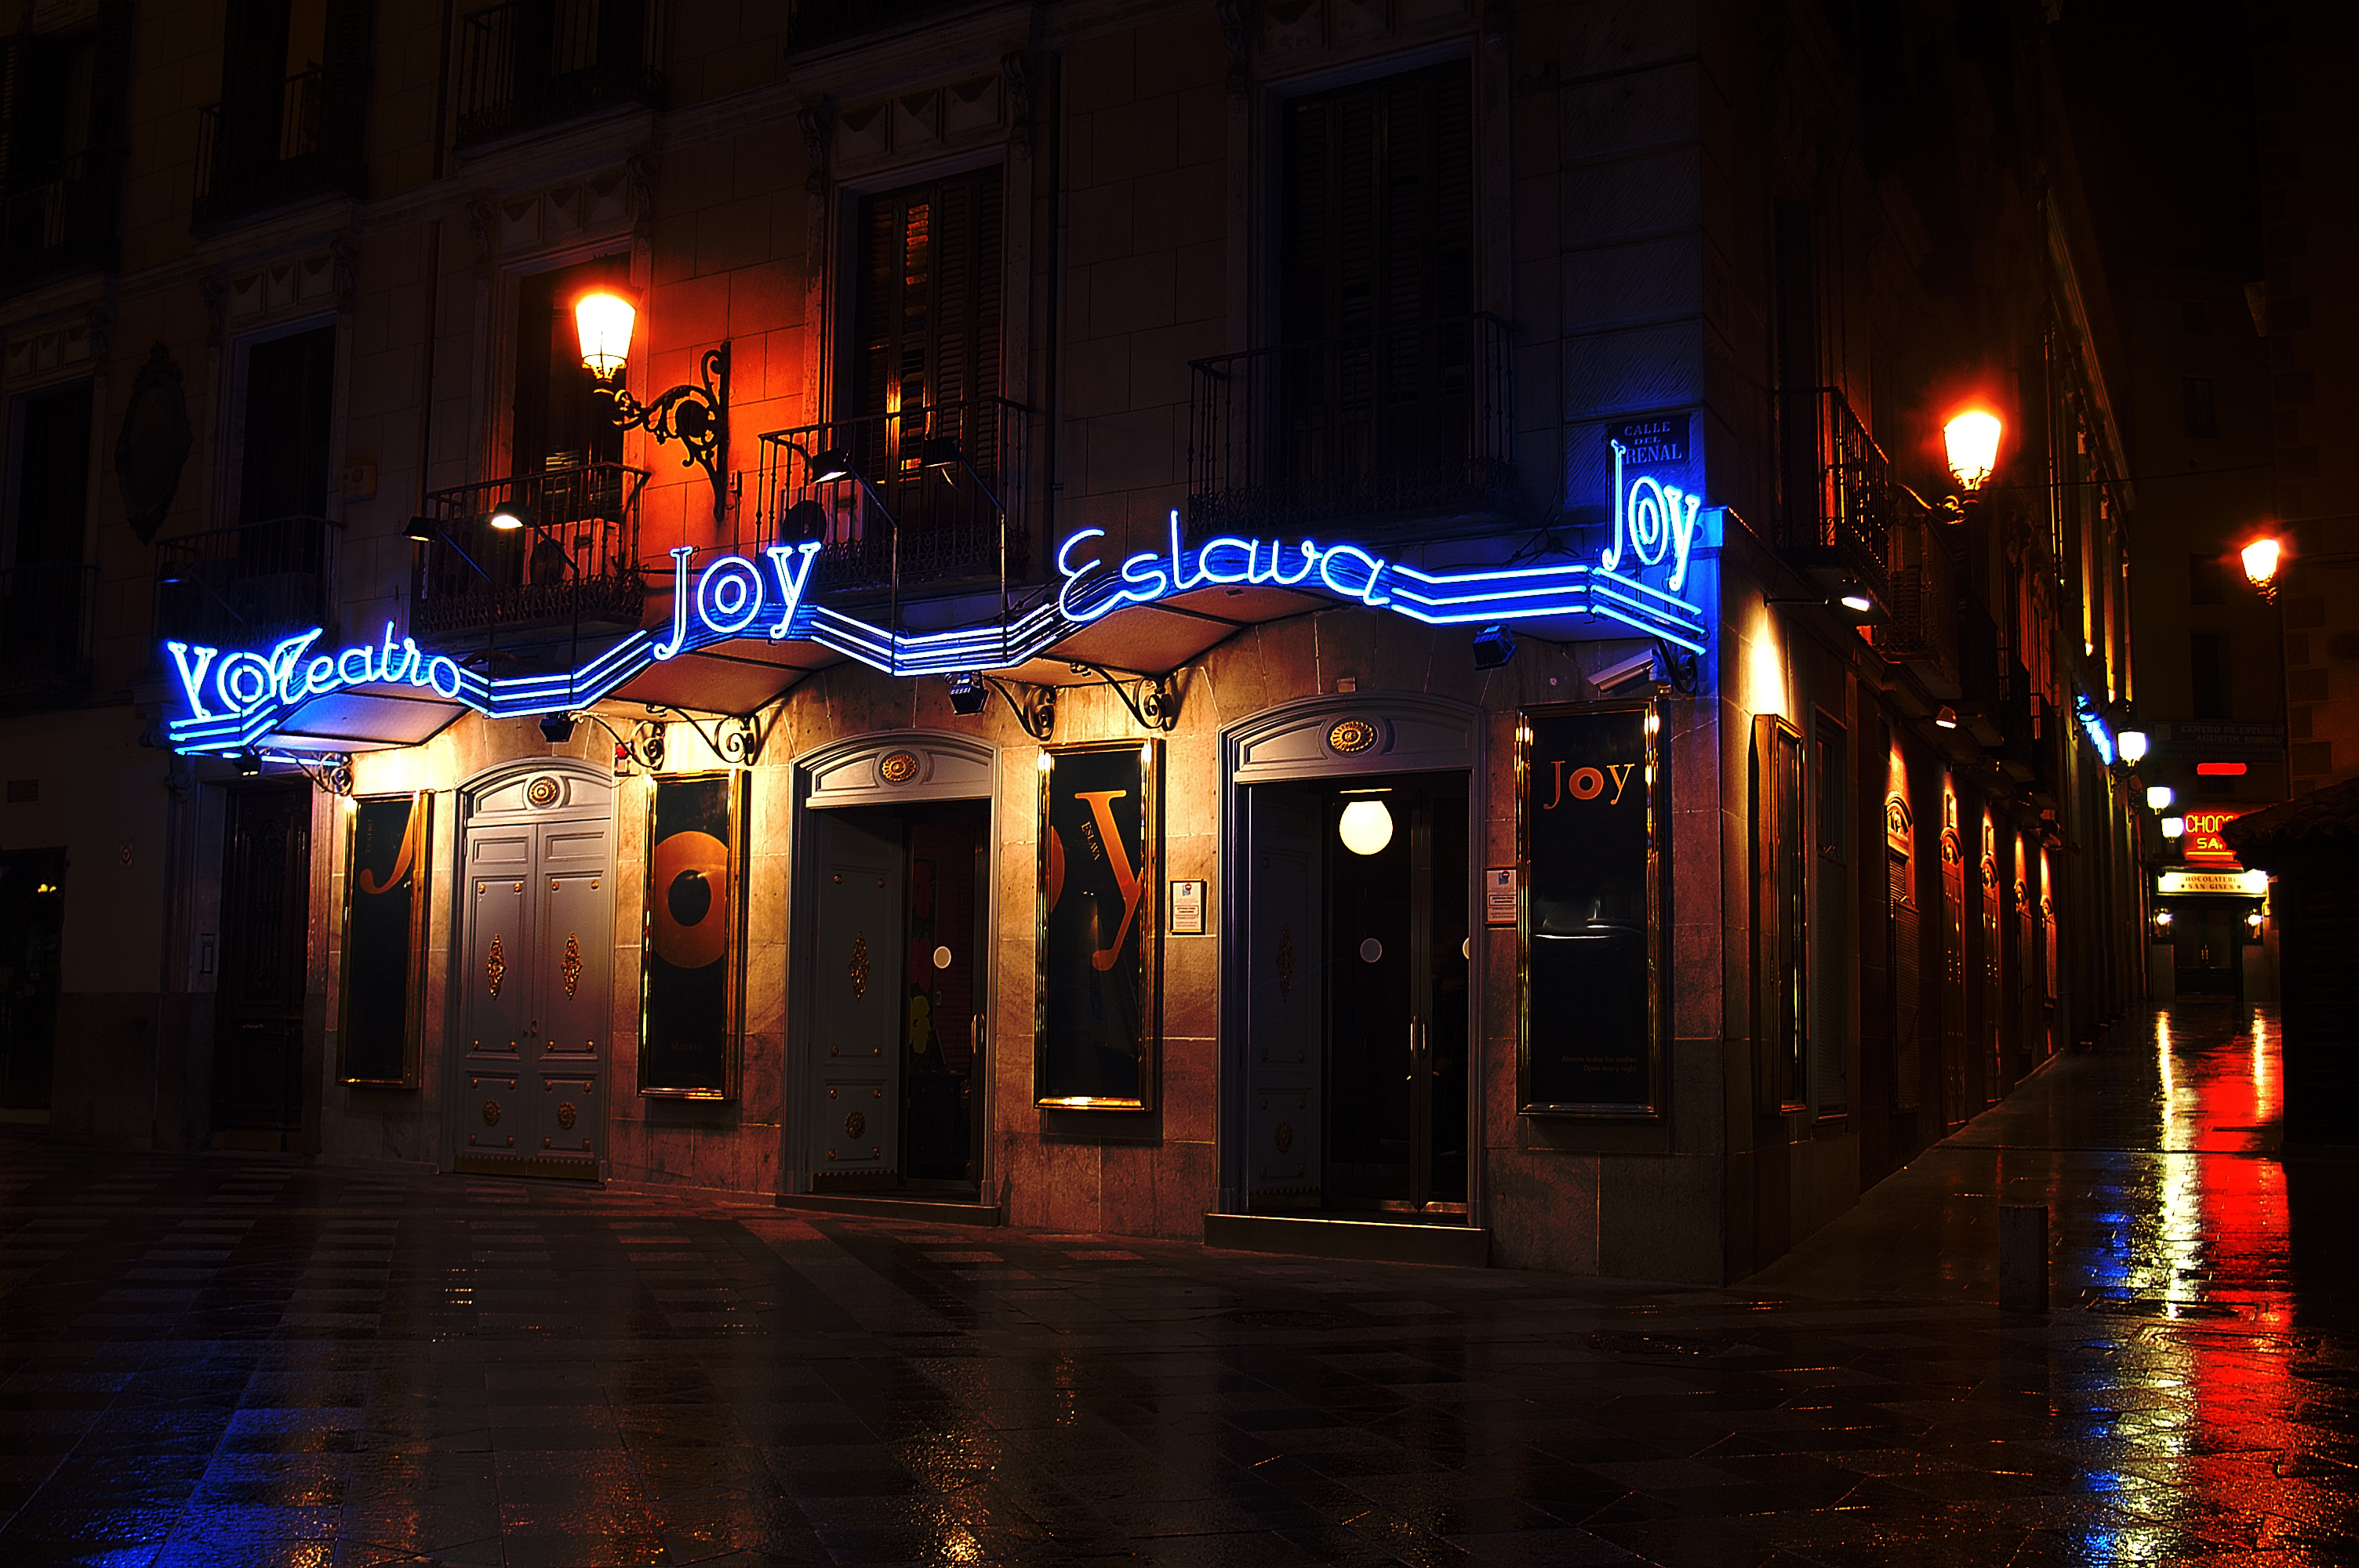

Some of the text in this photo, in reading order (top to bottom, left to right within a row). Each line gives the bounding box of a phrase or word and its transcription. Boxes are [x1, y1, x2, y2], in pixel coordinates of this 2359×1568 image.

[1624, 422, 1670, 436] CALLE
[1634, 436, 1661, 445] DEL
[1622, 443, 1682, 465] RENAL
[1059, 510, 1390, 622] Eslava
[270, 620, 461, 706] Teatro
[2181, 725, 2221, 734] CENTRO
[2185, 815, 2234, 833] CHOC
[2197, 837, 2223, 849] SA
